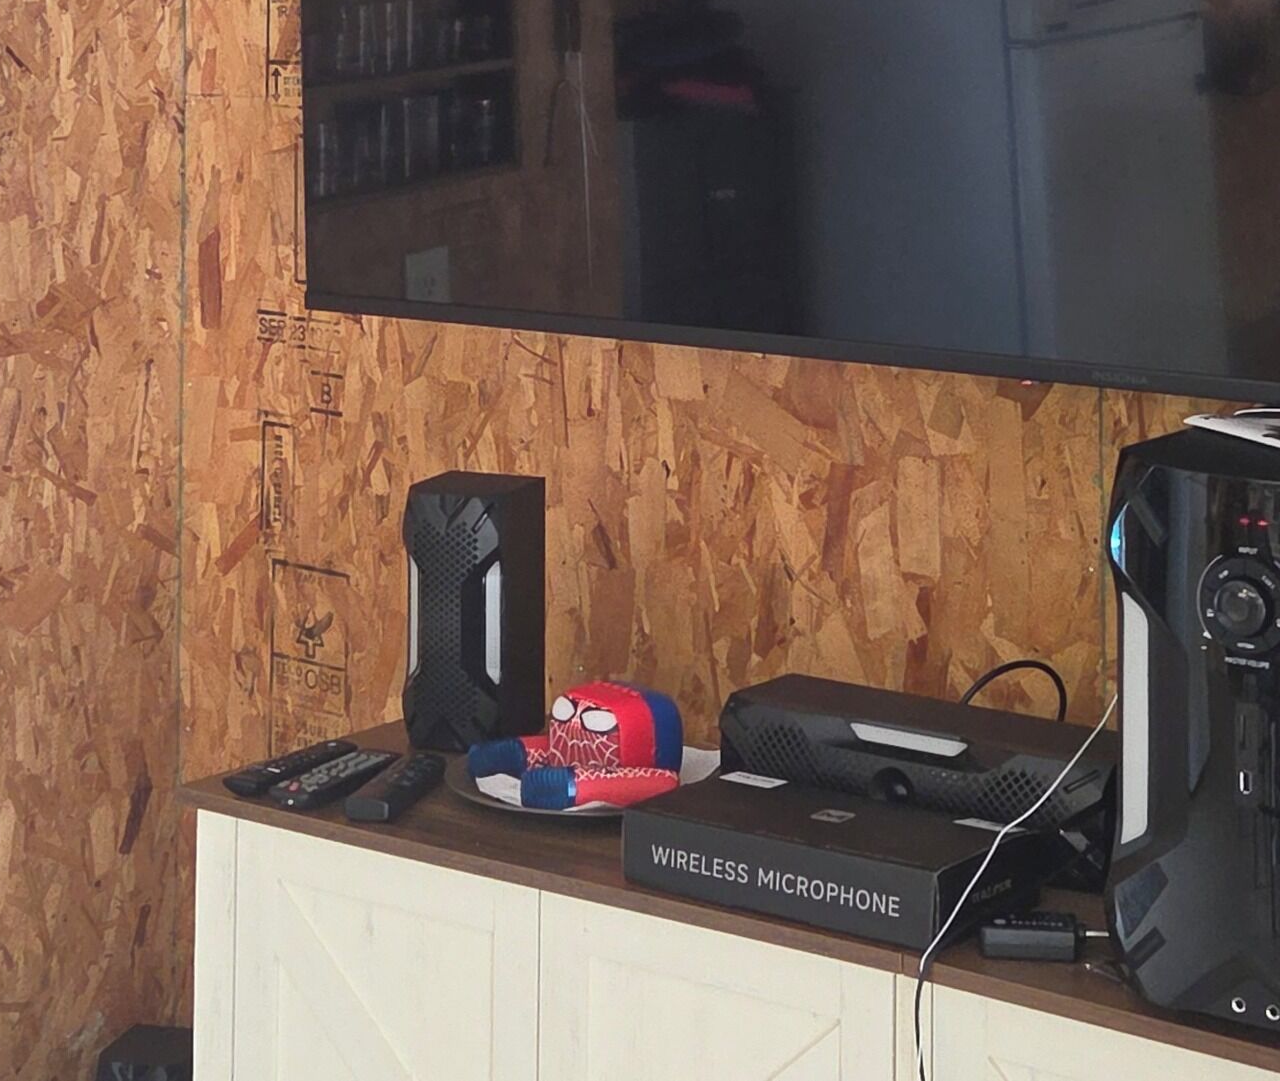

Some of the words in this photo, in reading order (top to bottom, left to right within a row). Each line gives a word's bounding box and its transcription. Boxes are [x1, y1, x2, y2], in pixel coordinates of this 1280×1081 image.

[305, 669, 341, 695] OSB
[651, 844, 749, 884] WIRELESS
[757, 867, 901, 918] MICROPHONE
